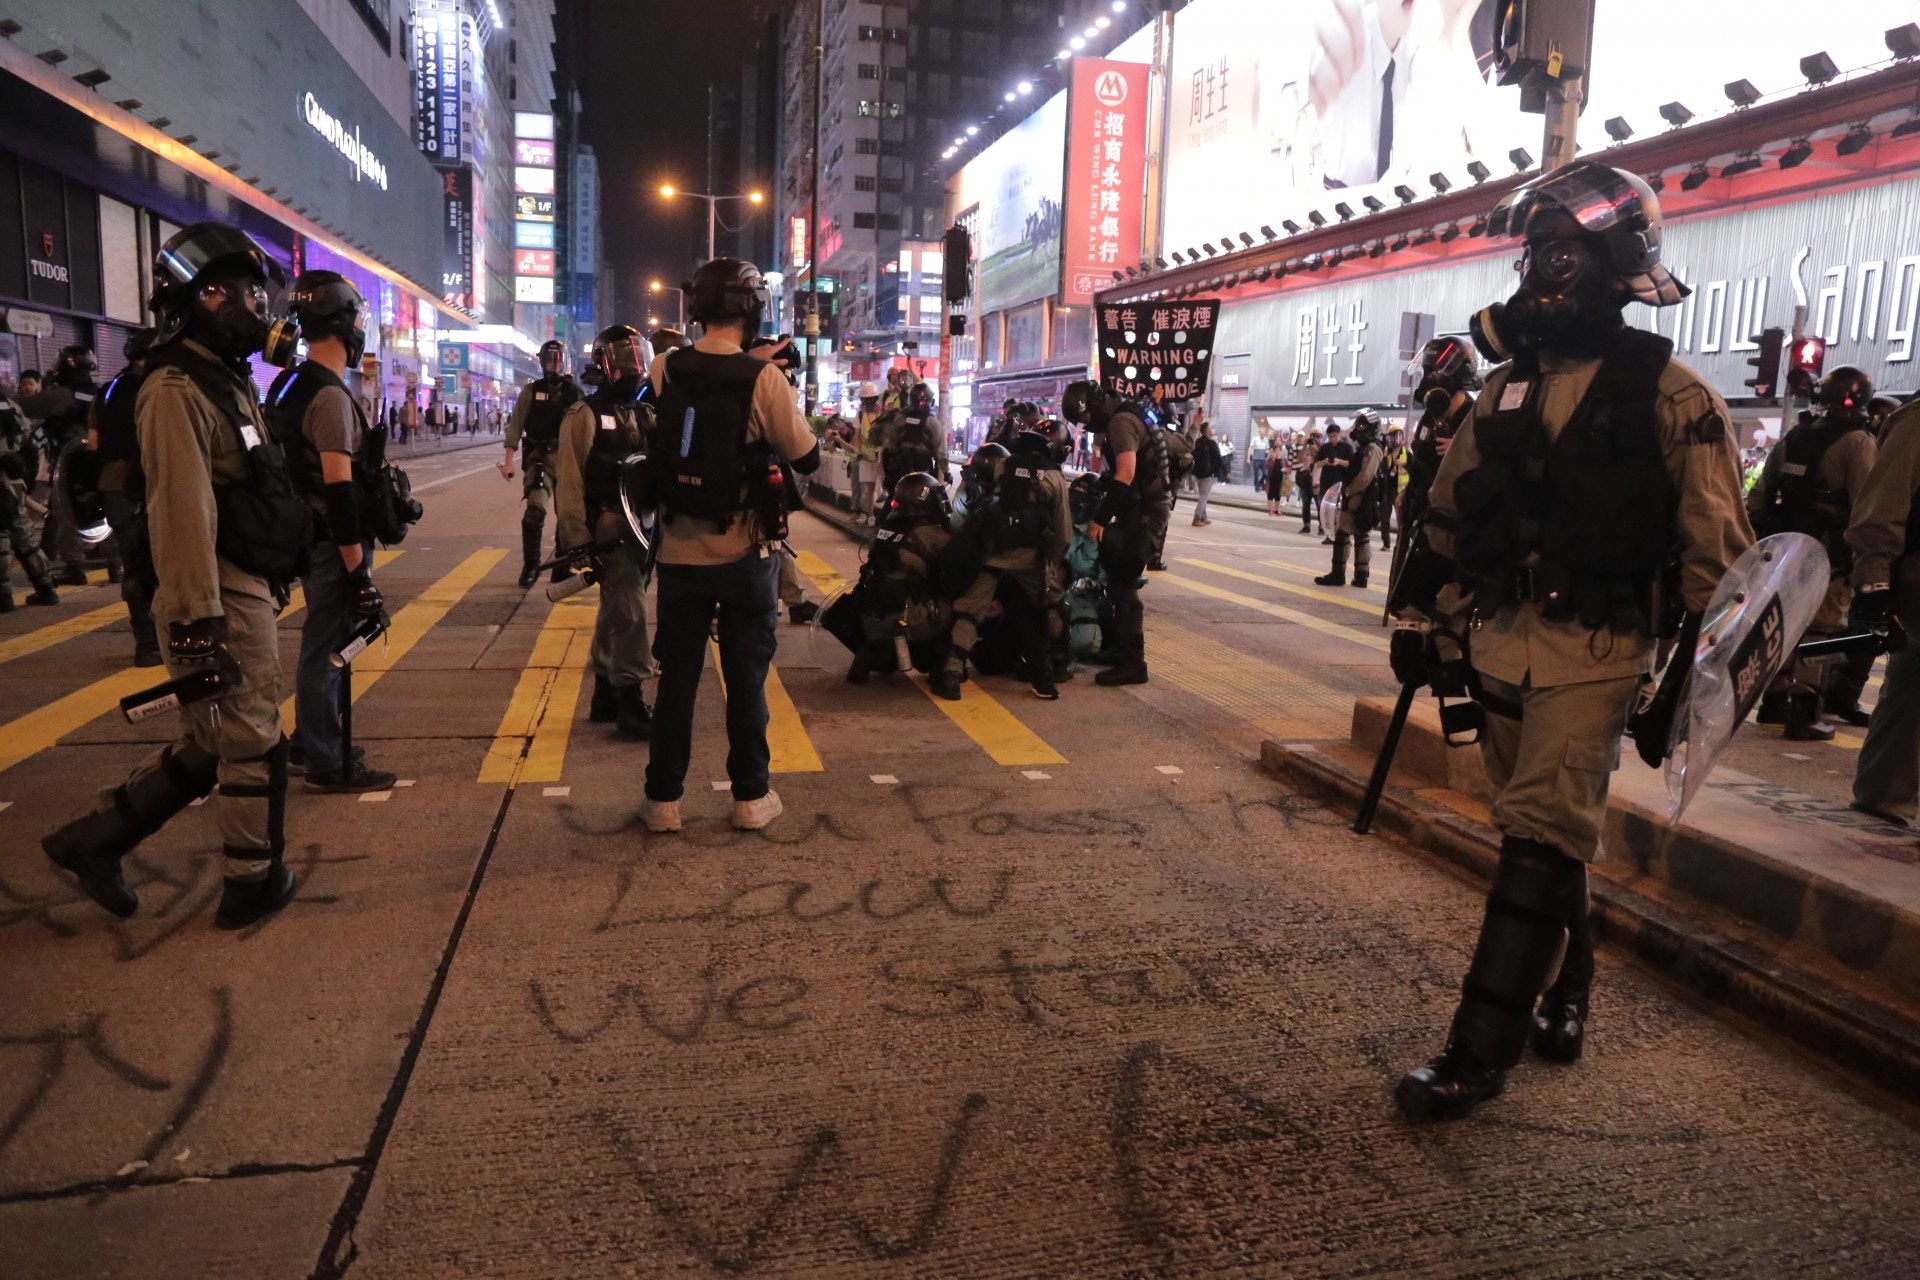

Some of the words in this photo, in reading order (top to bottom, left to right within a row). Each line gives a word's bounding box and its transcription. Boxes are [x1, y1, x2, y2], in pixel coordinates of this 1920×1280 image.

[1189, 53, 1230, 127] 周生生
[1093, 110, 1102, 138] CMB
[1091, 143, 1101, 179] WING
[1089, 184, 1099, 220] LUNG
[1098, 111, 1126, 264] 招商永隆銀行
[537, 201, 552, 212] 1/F
[1088, 226, 1097, 262] BANK
[31, 259, 69, 283] TUDOR
[442, 272, 463, 285] 2/F
[1104, 308, 1138, 330] 警告
[1117, 348, 1194, 366] WARNING
[1291, 298, 1368, 387] 周生生
